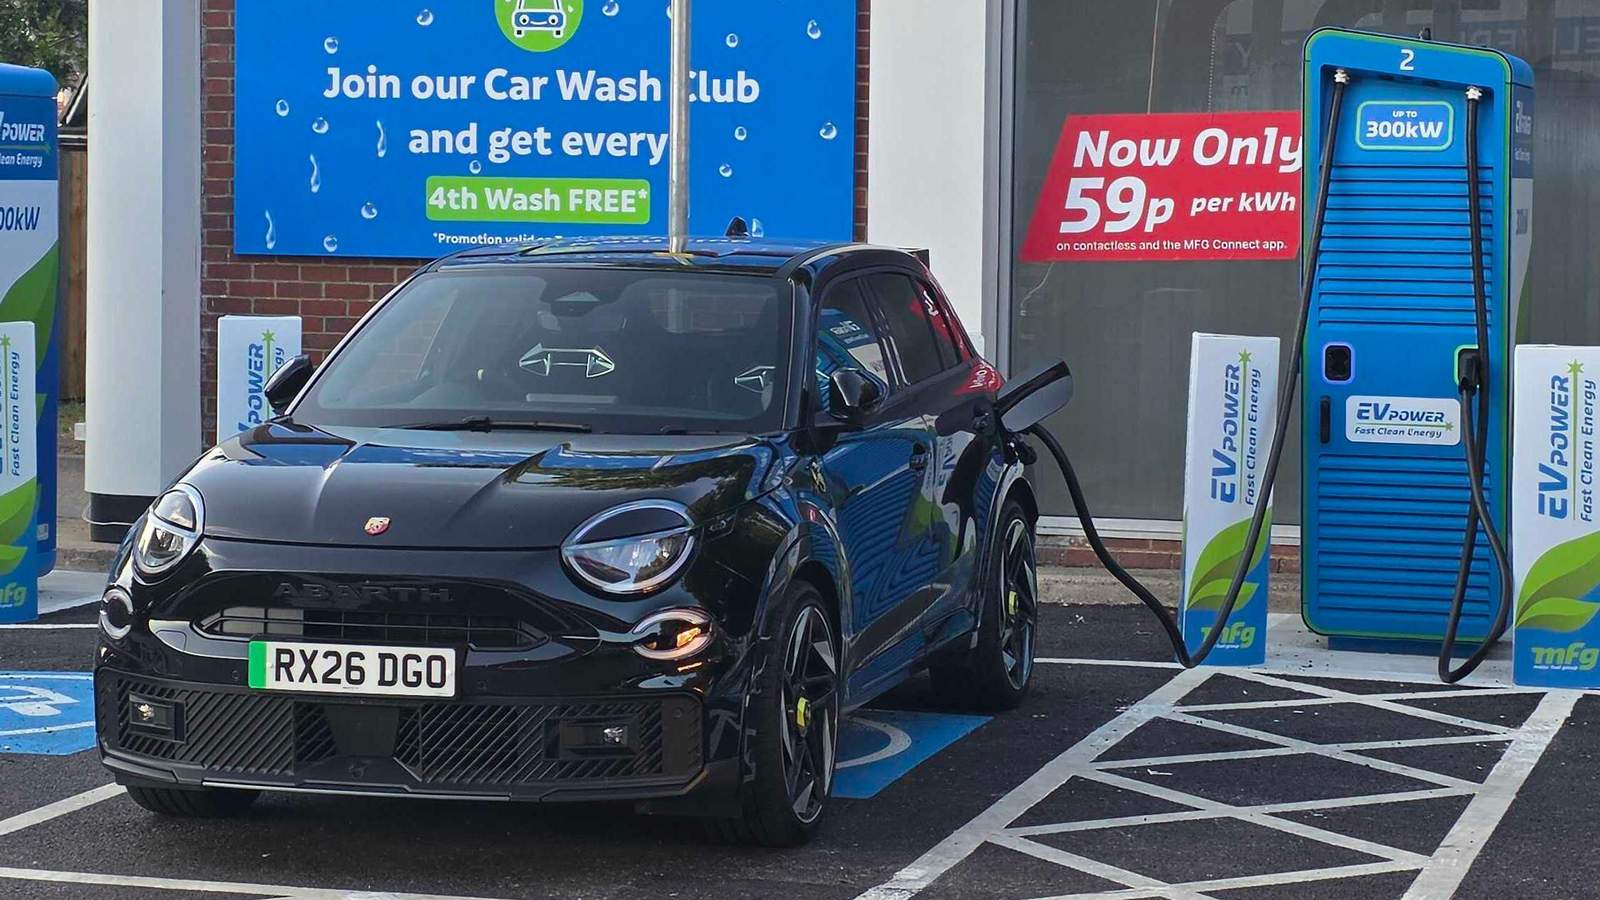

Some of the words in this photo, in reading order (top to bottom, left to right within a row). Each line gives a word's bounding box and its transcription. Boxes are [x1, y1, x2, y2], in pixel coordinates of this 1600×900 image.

[1400, 49, 1415, 71] 2
[323, 64, 401, 99] Join
[411, 76, 476, 100] our
[484, 68, 548, 101] Car
[556, 69, 661, 102] Wash
[1366, 121, 1444, 138] 300kW
[1392, 110, 1405, 118] UP
[1406, 110, 1418, 118] TO
[16, 152, 43, 168] Energy
[408, 122, 478, 155] and
[488, 126, 552, 164] get
[561, 131, 669, 165] every
[1073, 130, 1180, 168] Now
[1193, 127, 1303, 173] Only
[428, 187, 477, 211] 4th
[485, 187, 560, 212] Wash
[1059, 176, 1175, 234] 59p
[1190, 193, 1233, 217] per
[1238, 191, 1296, 212] kWh
[1056, 242, 1070, 251] on
[1073, 240, 1137, 251] contactless
[1139, 240, 1160, 251] and
[1163, 240, 1181, 250] the
[1183, 240, 1209, 250] MFG
[1213, 239, 1259, 250] Connect
[1262, 241, 1287, 251] app.
[10, 351, 20, 401] Energy
[238, 343, 264, 431] POWER
[1248, 368, 1261, 422] Energy
[1581, 379, 1596, 436] Energy
[10, 405, 19, 444] Clean
[1355, 426, 1375, 435] Fast
[1377, 427, 1405, 436] Clean
[1407, 428, 1442, 439] Energy
[11, 447, 20, 476] Fast
[1246, 427, 1256, 469] Clean
[1580, 441, 1593, 485] Clean
[1244, 471, 1255, 506] Fast
[1580, 489, 1593, 522] Fast
[273, 582, 450, 601] ABARTH
[275, 648, 366, 685] RX26
[377, 652, 447, 689] DGO
[1531, 642, 1600, 671] mfg
